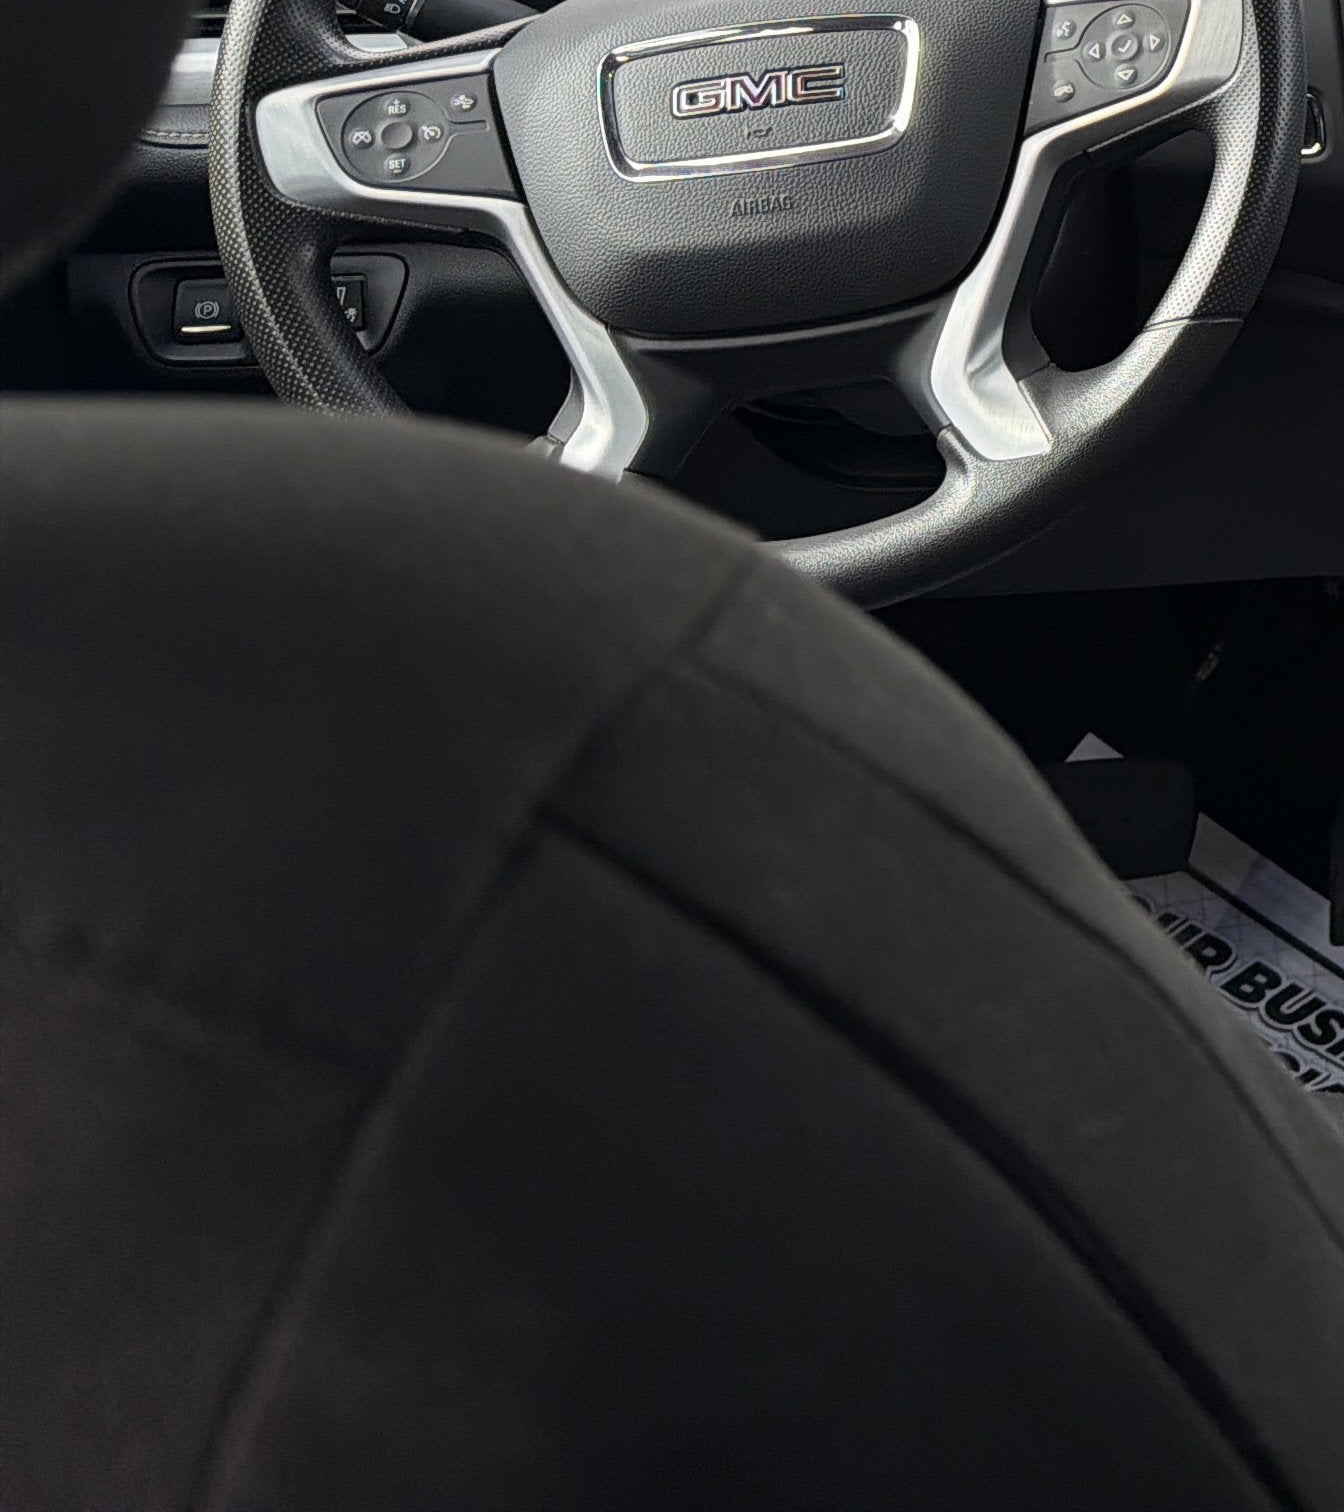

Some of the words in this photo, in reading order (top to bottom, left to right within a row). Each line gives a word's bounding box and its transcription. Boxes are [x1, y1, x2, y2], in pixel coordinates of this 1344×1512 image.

[673, 64, 845, 119] GMC
[388, 103, 407, 115] RES
[388, 158, 406, 169] SET
[731, 196, 793, 217] AIRBAG
